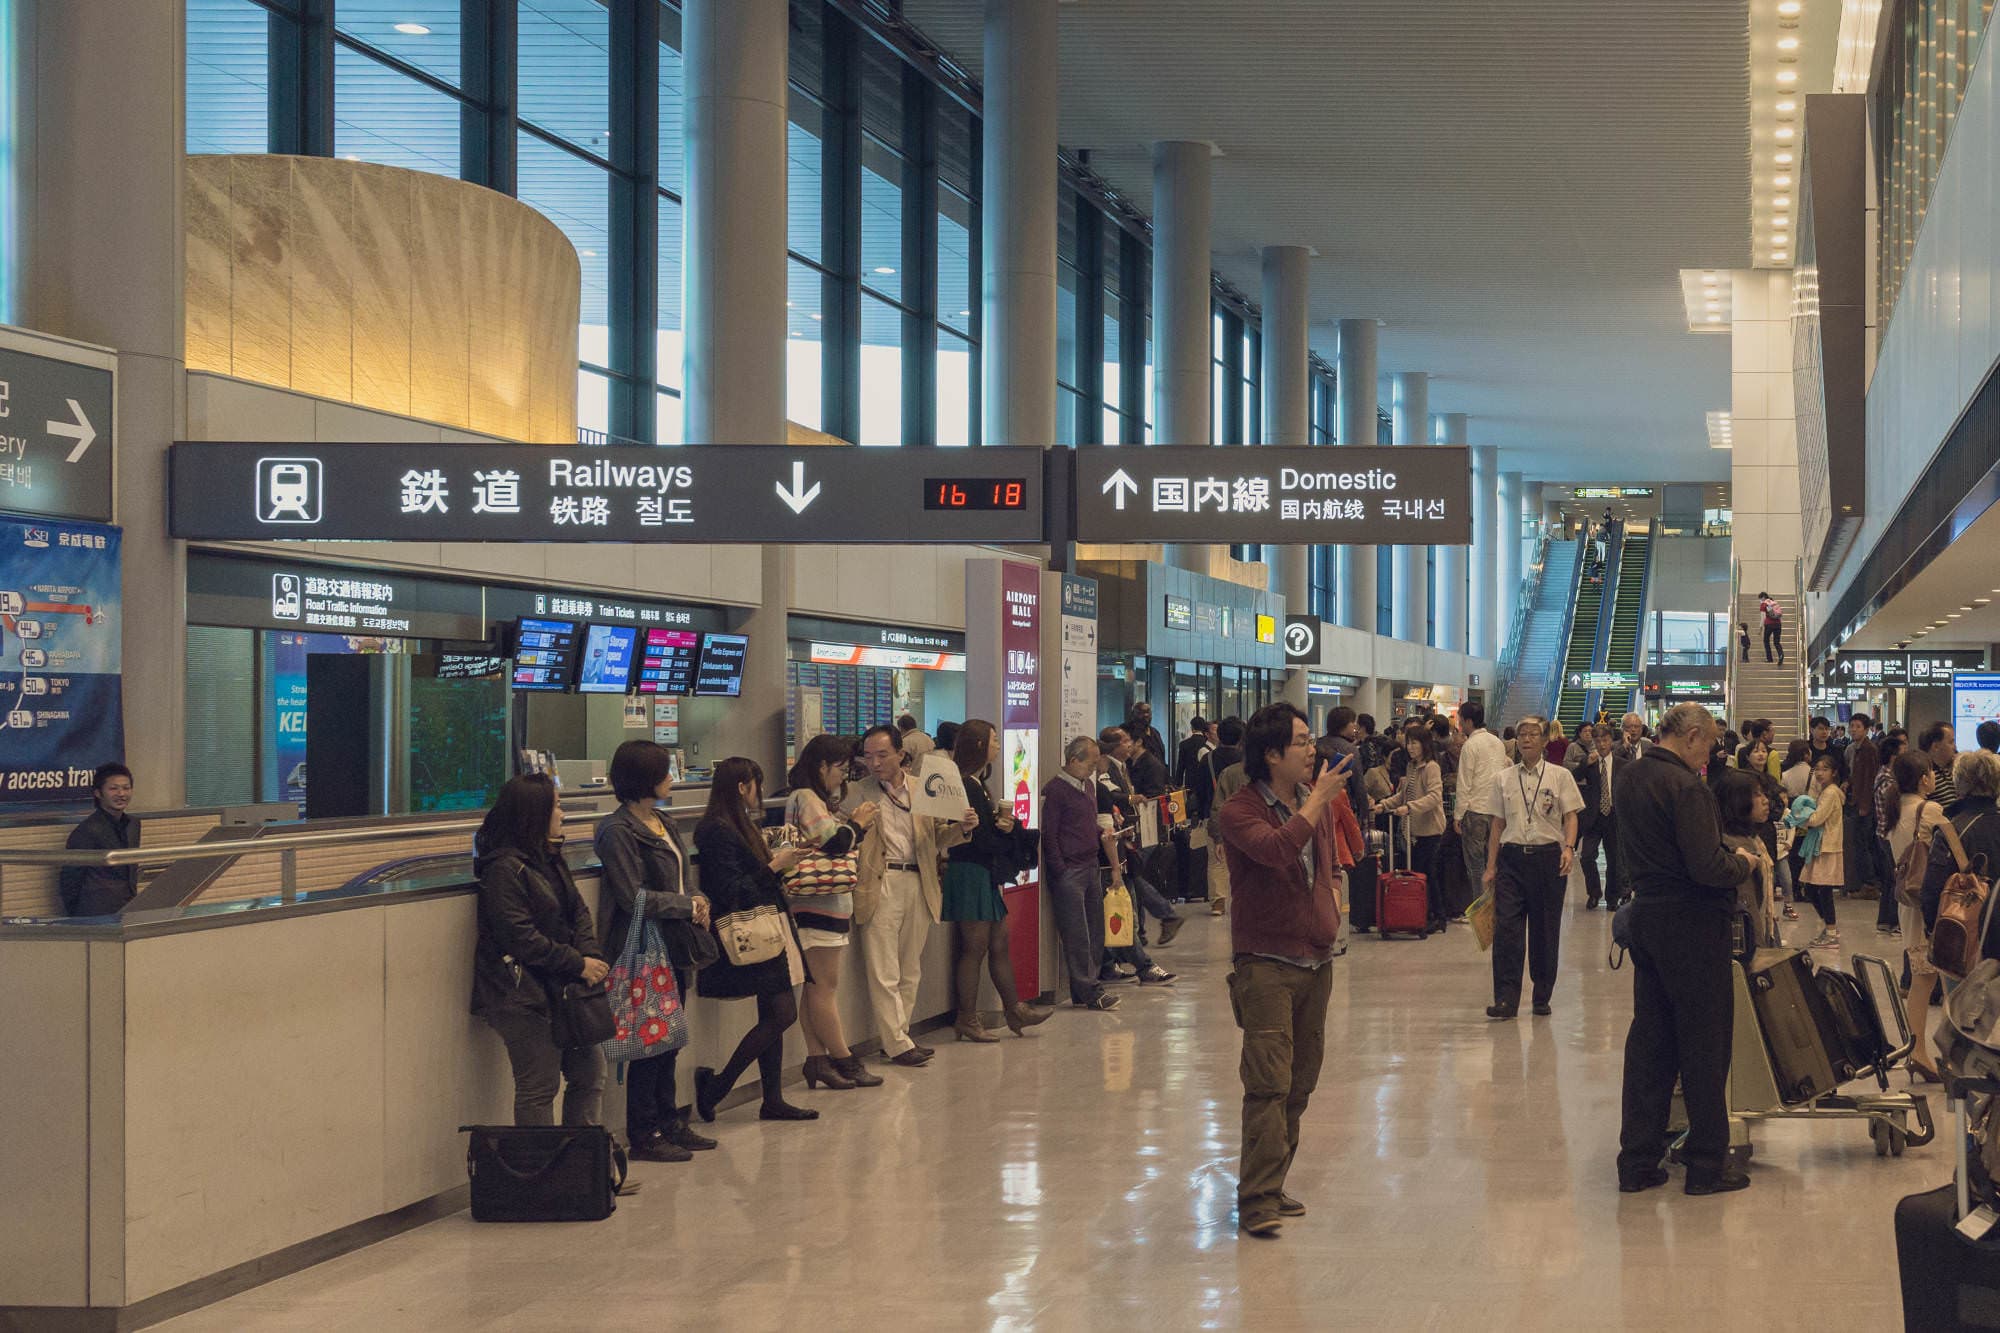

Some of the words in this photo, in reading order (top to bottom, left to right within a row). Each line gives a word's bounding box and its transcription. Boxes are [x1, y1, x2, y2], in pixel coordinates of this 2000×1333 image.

[550, 459, 692, 494] Railways
[1281, 467, 1397, 491] Domestic
[1152, 476, 1271, 513] 国内線
[550, 495, 611, 526] 铁路
[635, 495, 695, 526] 철도
[1281, 499, 1365, 520] 国内航线
[1381, 499, 1446, 520] 국내선
[305, 577, 393, 602] 道路交通情報案内
[1006, 590, 1036, 606] AIRPORT
[305, 599, 326, 611] Road
[326, 600, 349, 613] Traffic
[350, 602, 388, 616] Information
[599, 605, 615, 617] Train
[615, 606, 635, 619] Tickets
[1012, 604, 1032, 618] MALL
[1025, 651, 1036, 675] 4F
[8, 771, 64, 790] access
